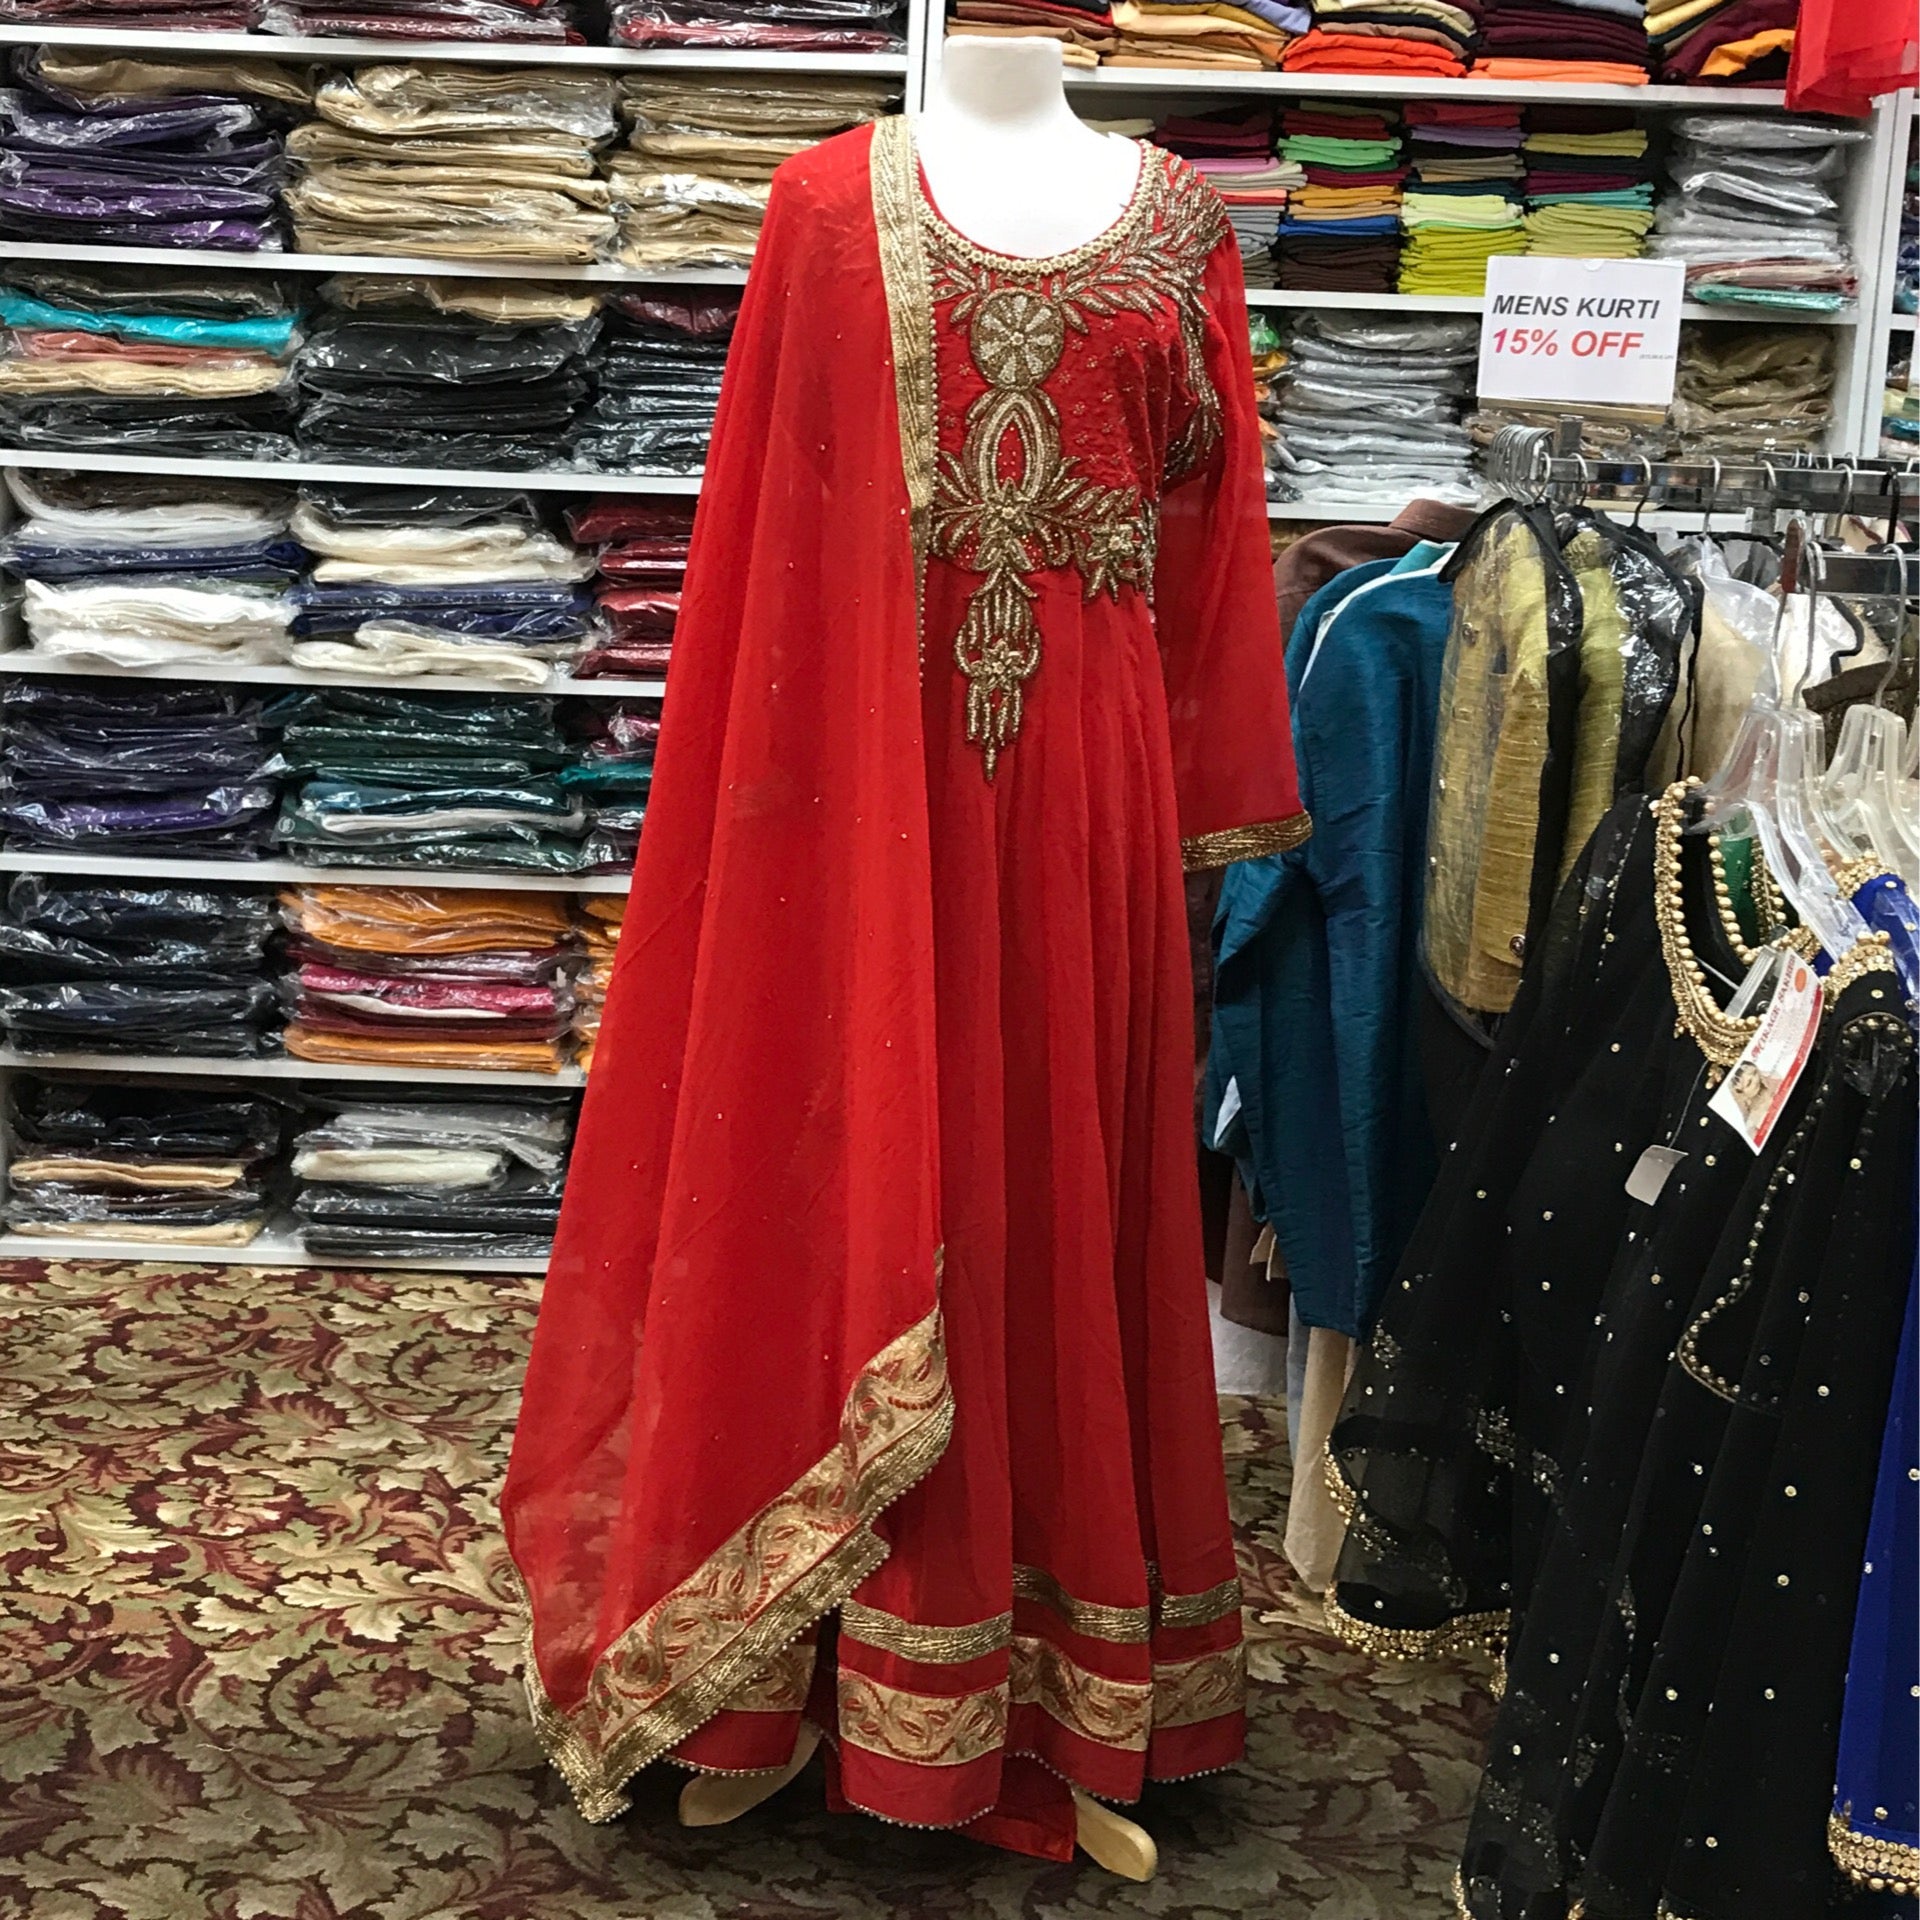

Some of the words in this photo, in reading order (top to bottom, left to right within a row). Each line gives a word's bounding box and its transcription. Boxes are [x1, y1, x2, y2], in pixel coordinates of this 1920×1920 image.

[1492, 295, 1569, 316] MENS
[1576, 298, 1660, 319] KURTI
[1493, 328, 1558, 356] 15%
[1571, 330, 1644, 358] OFF
